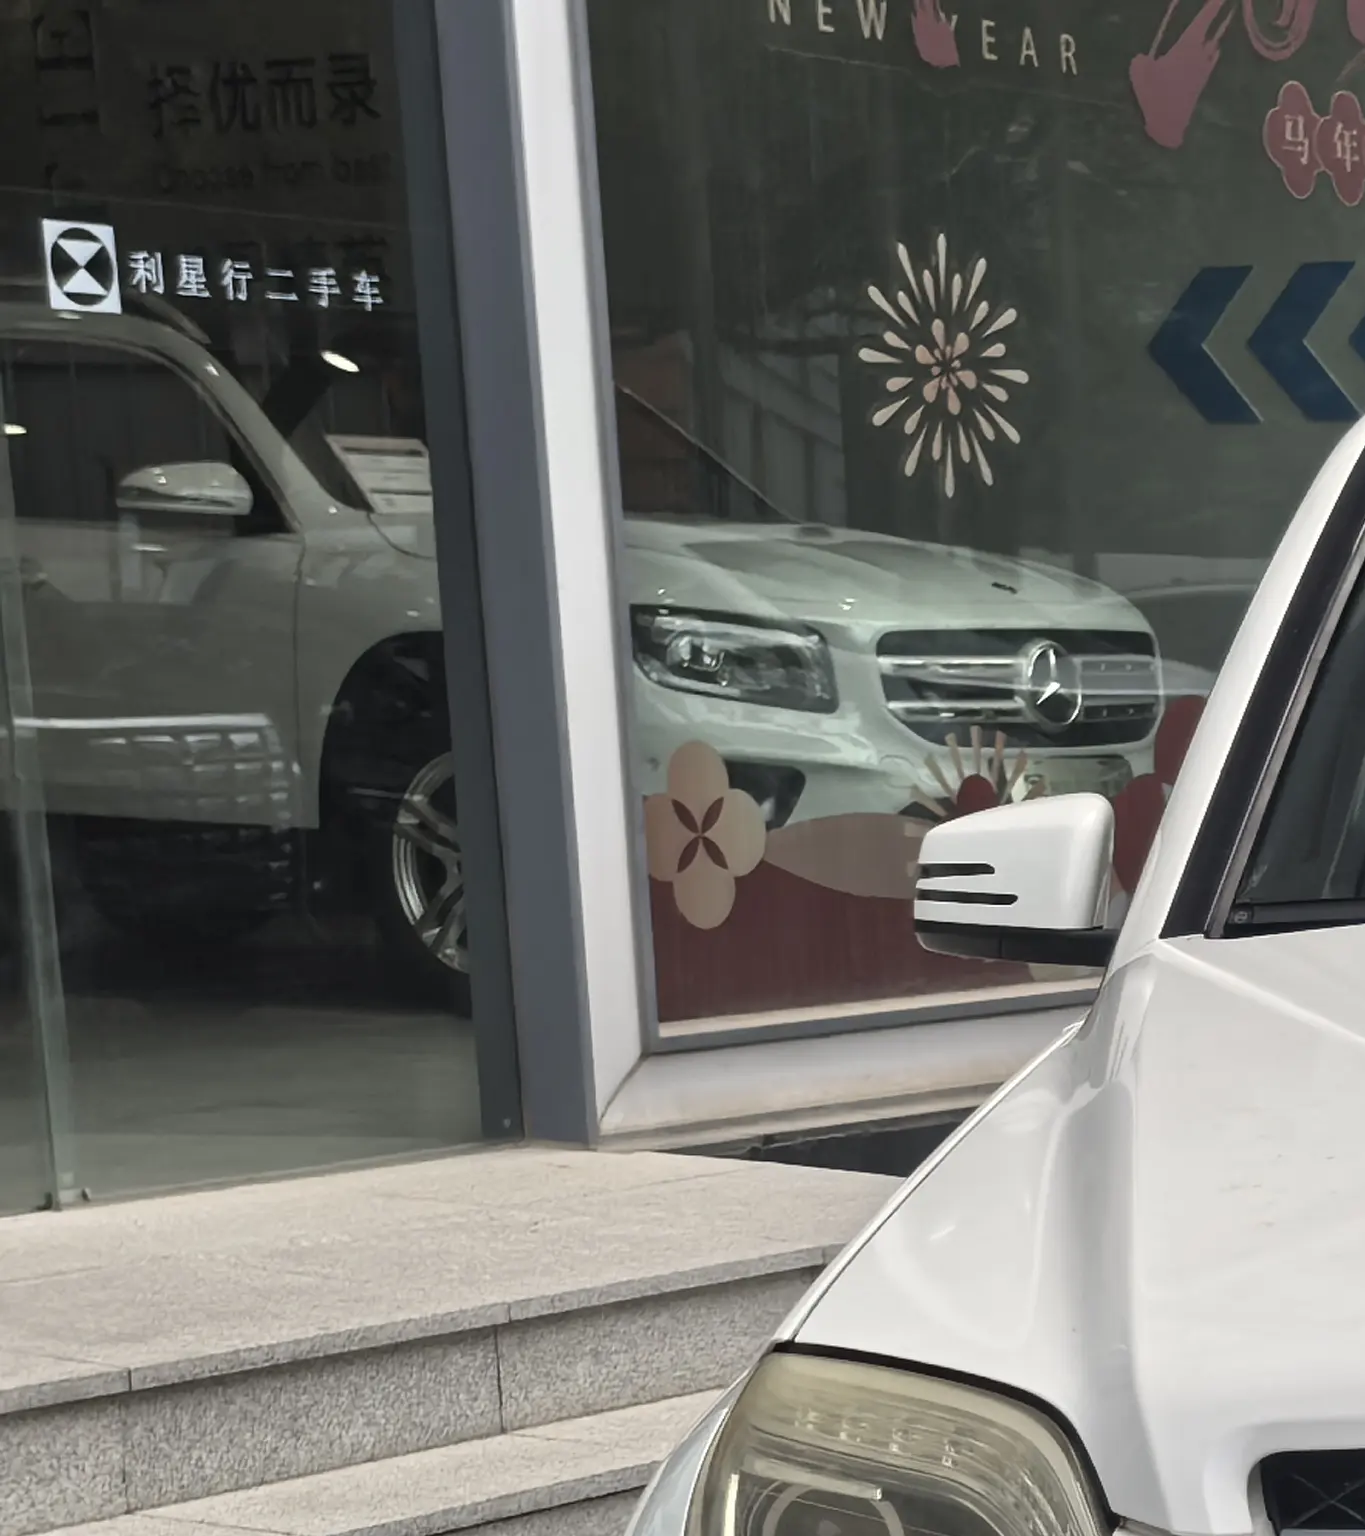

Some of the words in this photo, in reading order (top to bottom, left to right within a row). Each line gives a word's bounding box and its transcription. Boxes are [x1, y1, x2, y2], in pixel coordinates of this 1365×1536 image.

[766, 0, 888, 41] NEW
[147, 52, 382, 138] 择优而录
[127, 249, 385, 312] 利星行二手车
